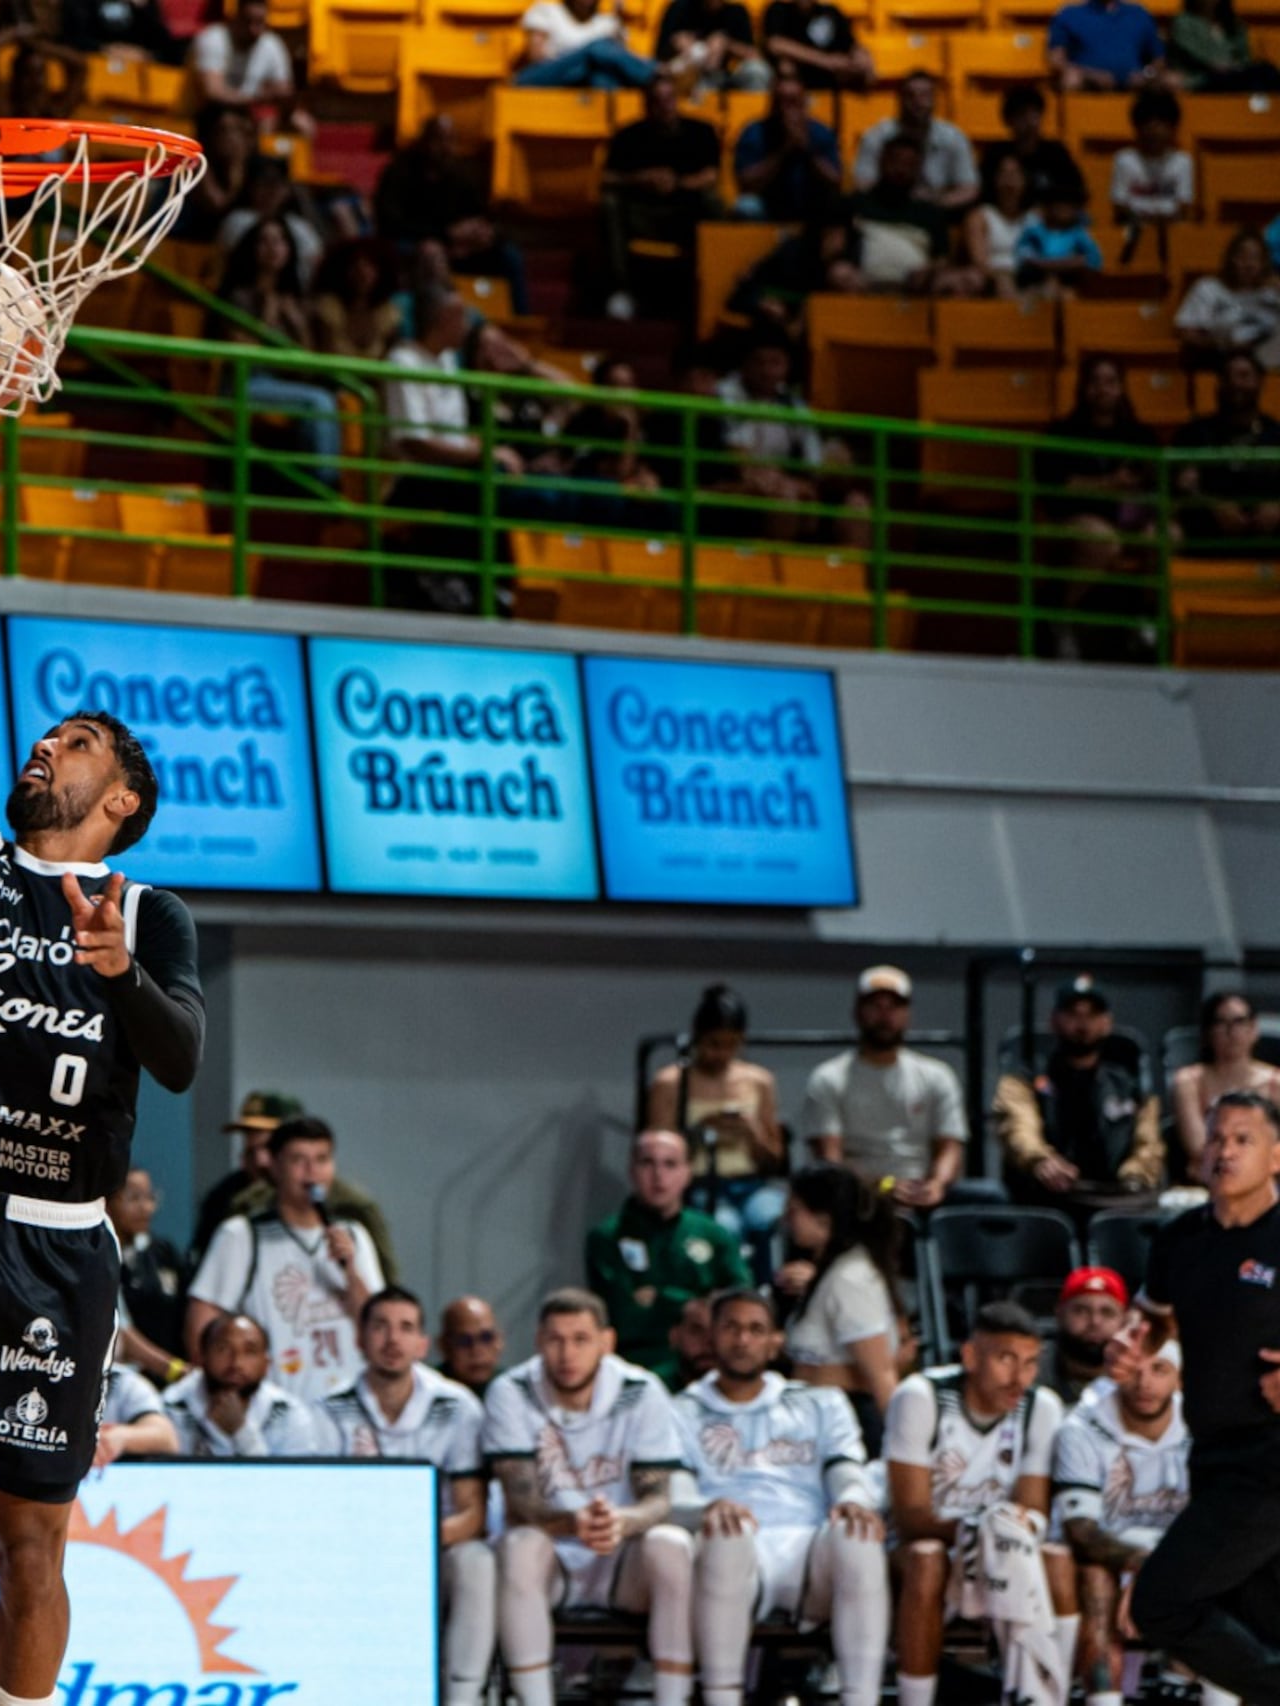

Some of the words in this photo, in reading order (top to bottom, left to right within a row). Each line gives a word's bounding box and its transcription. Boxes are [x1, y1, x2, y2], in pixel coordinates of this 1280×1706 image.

[34, 648, 284, 731] Conecta
[333, 665, 566, 747] Conecta
[607, 683, 819, 757] Conecta
[347, 746, 563, 821] Brunch
[622, 762, 819, 829] Brunch
[50, 1053, 88, 1107] 0
[0, 1137, 71, 1166] MASTER
[0, 1345, 76, 1383] Wendy's
